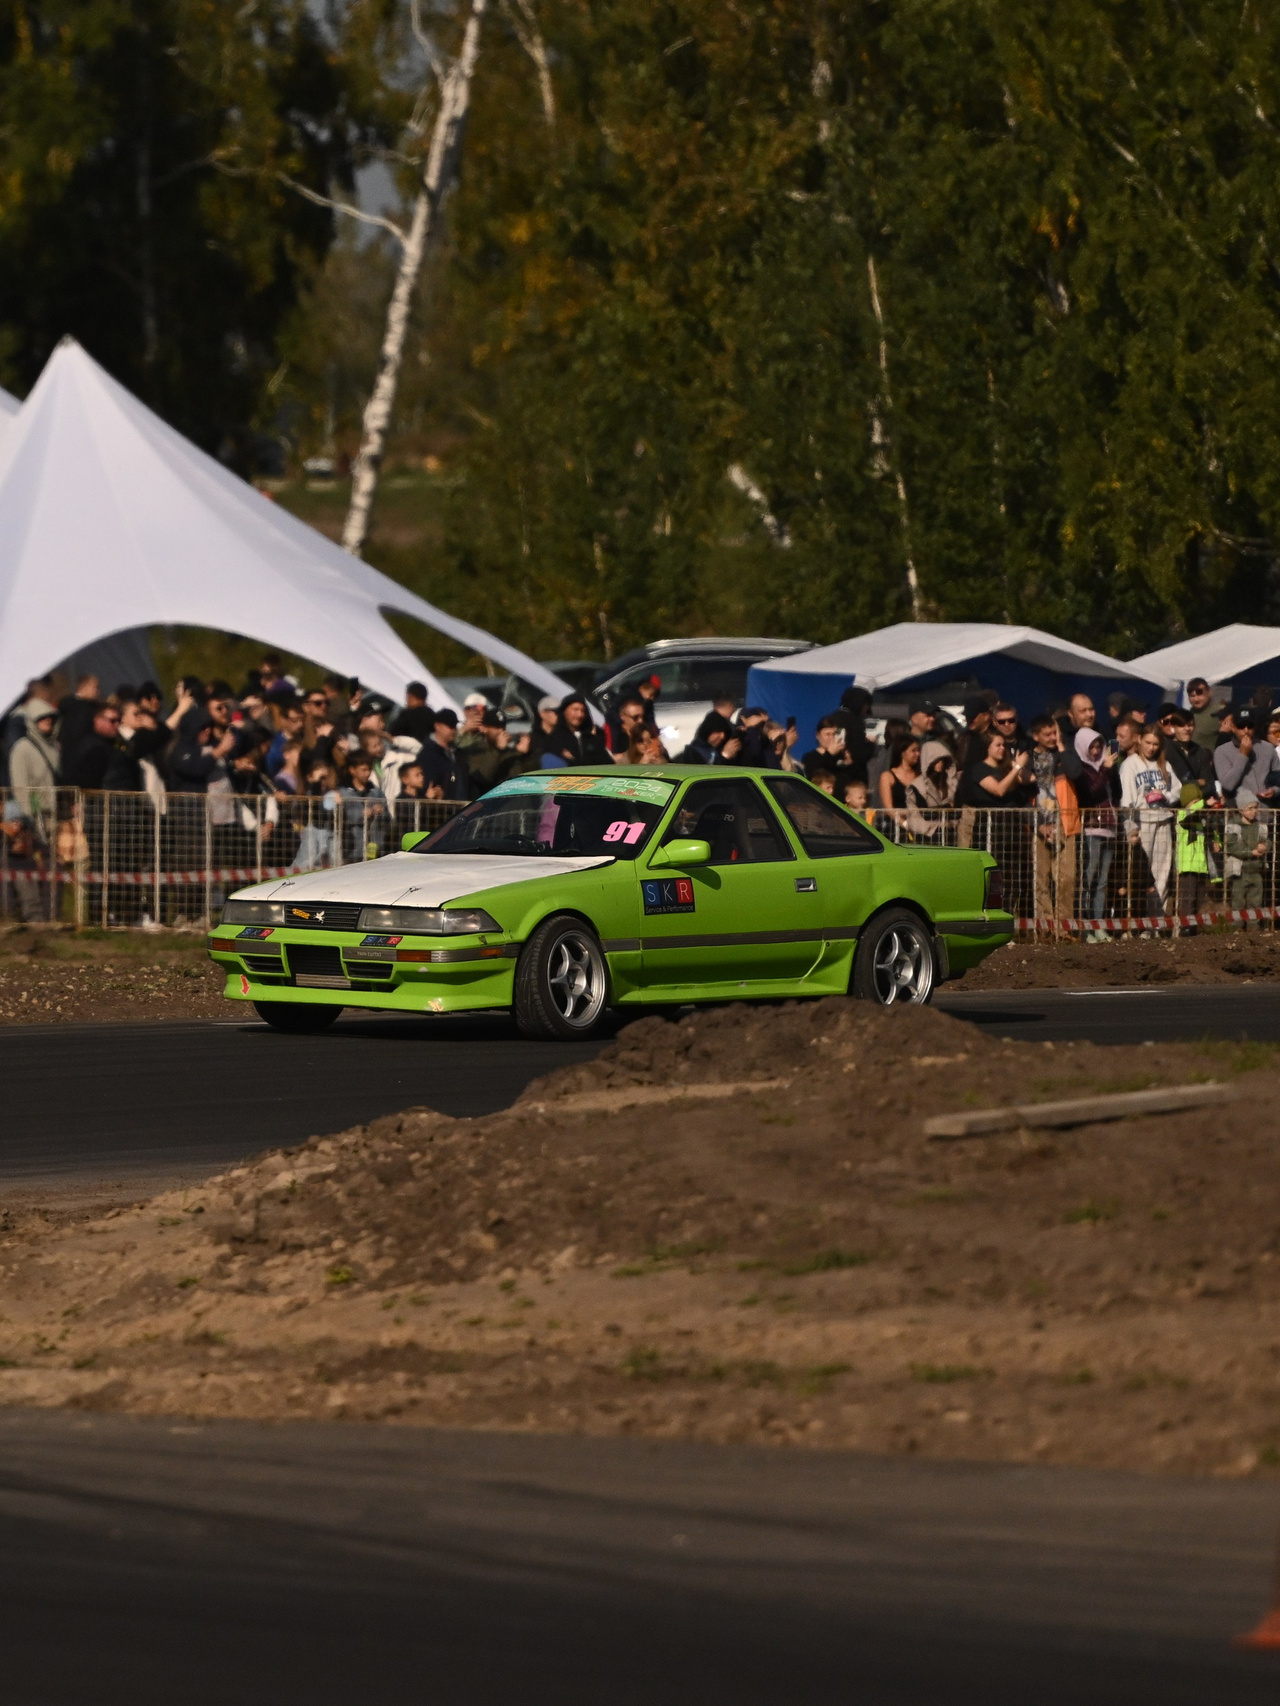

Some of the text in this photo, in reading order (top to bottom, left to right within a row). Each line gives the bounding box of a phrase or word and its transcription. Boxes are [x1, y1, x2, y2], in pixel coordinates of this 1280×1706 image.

[612, 779, 662, 793] 2024
[603, 820, 647, 845] 91
[646, 882, 690, 903] SKR
[365, 936, 400, 945] SKR
